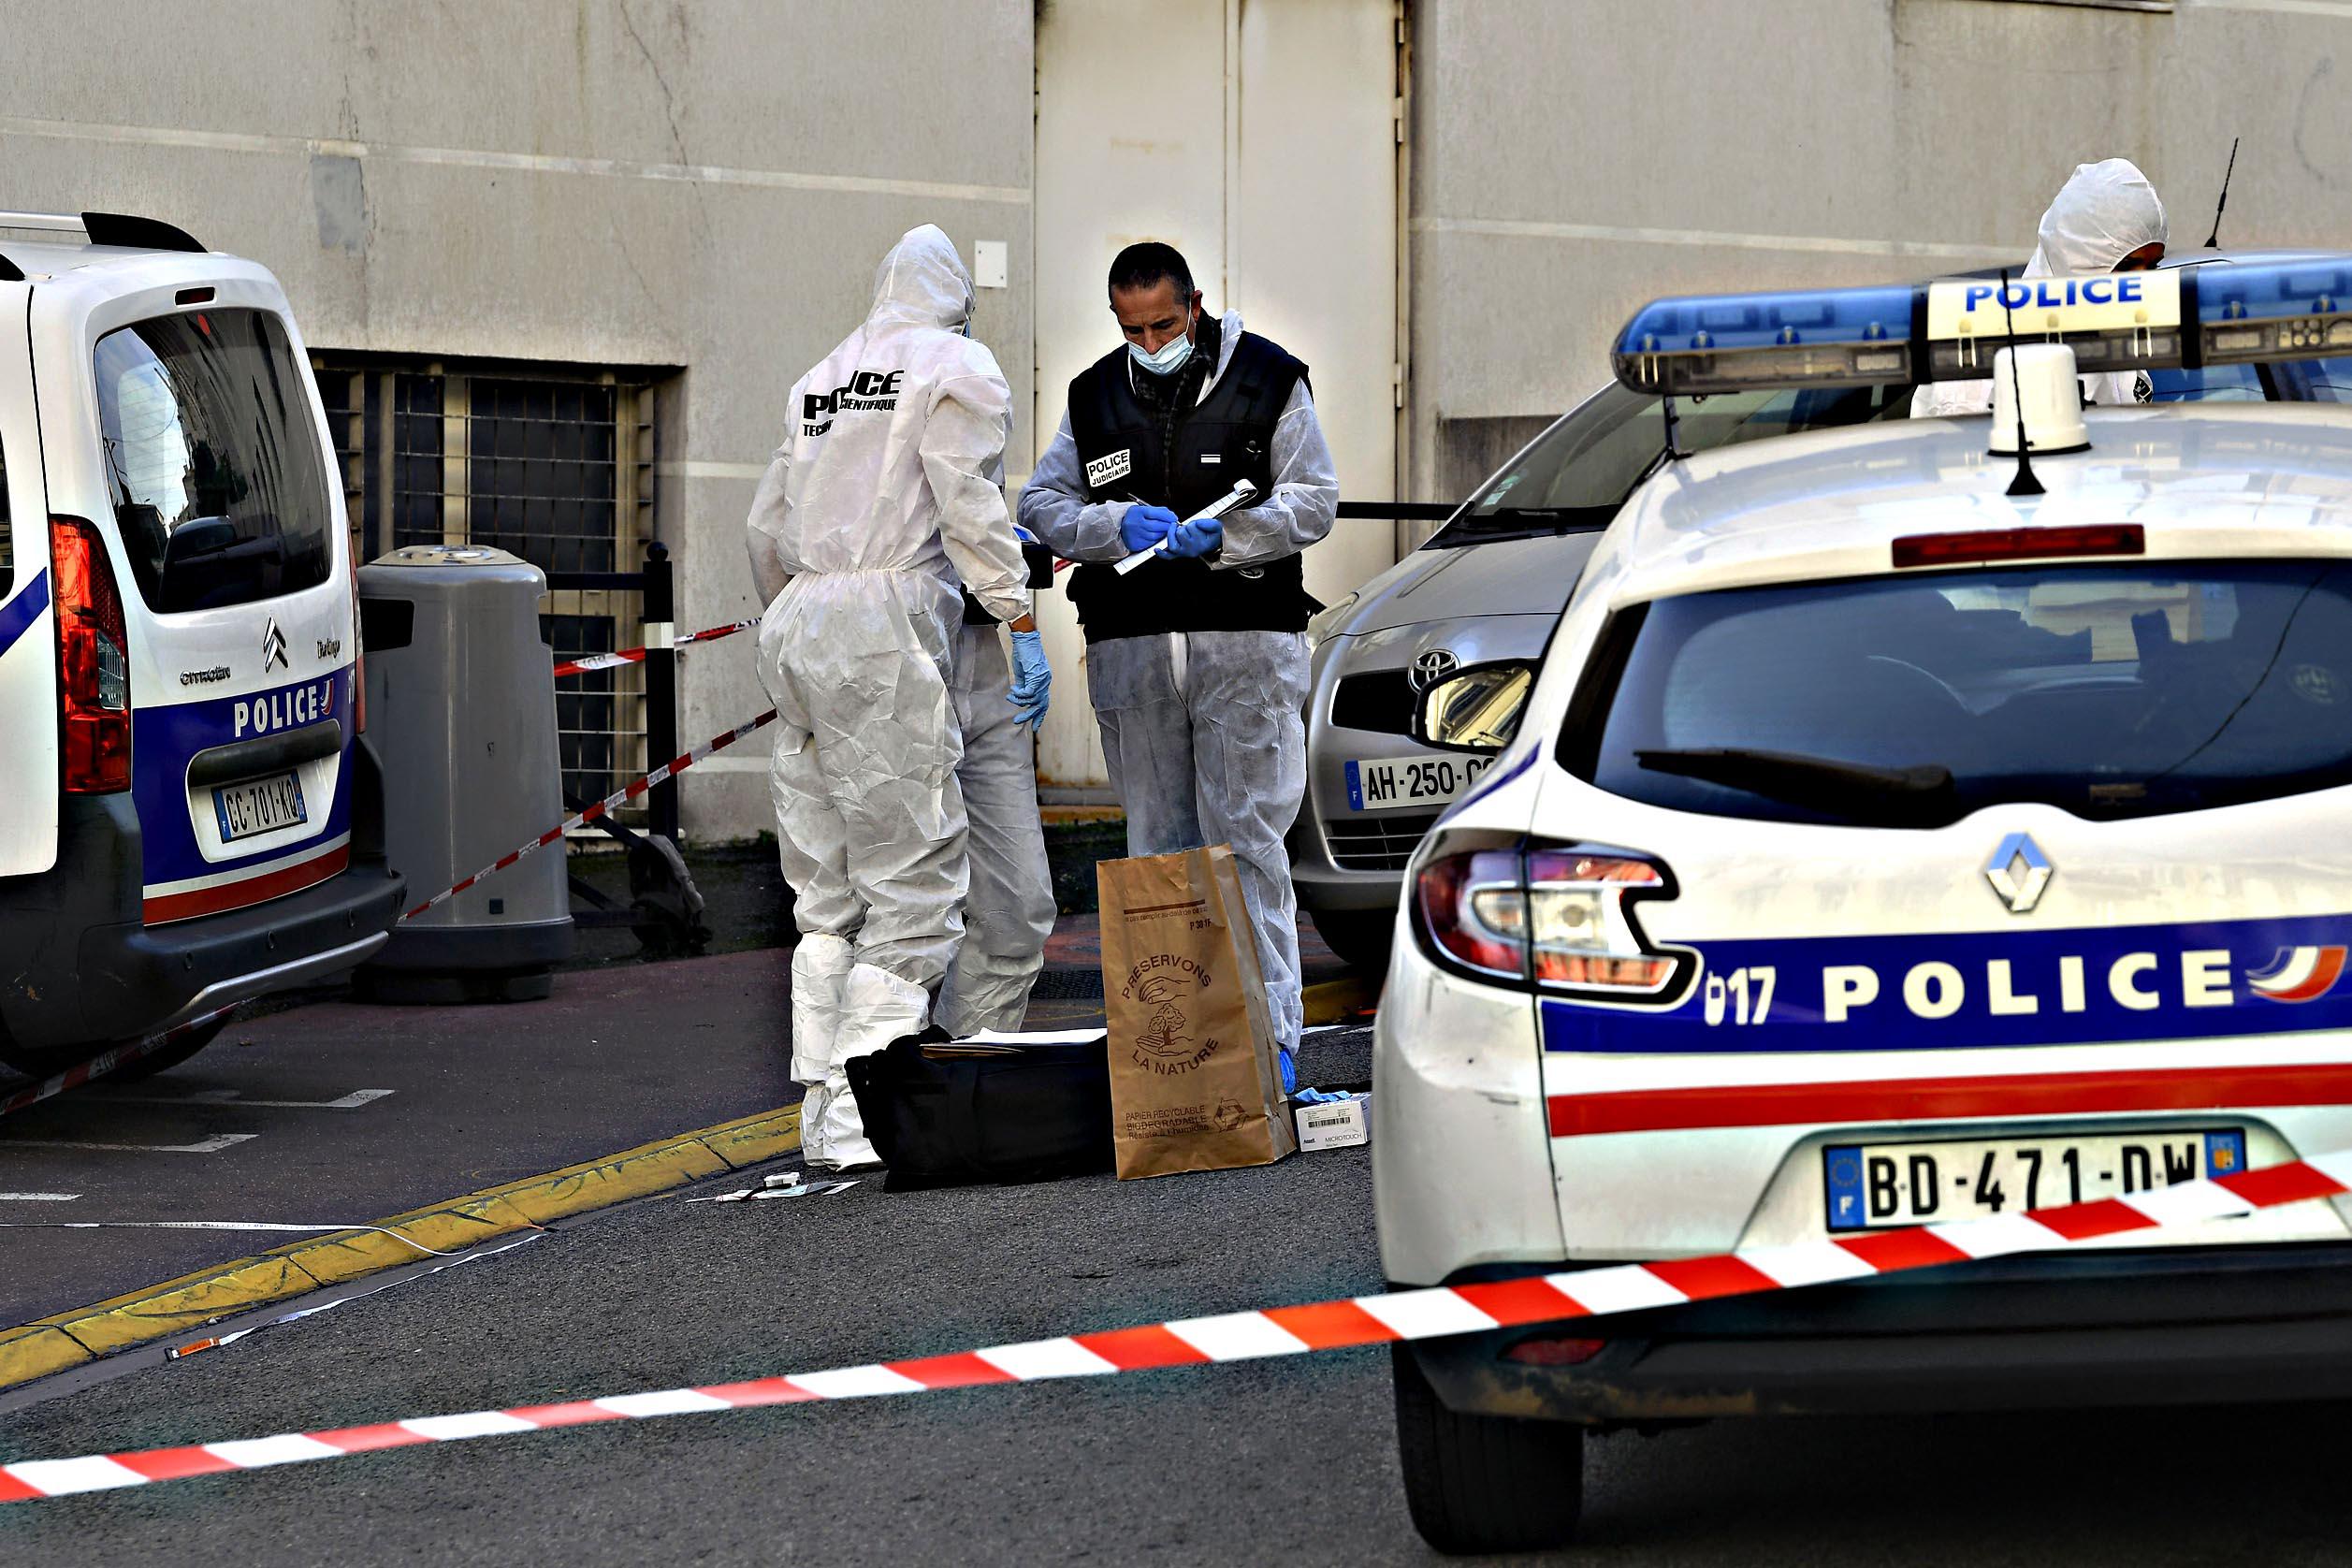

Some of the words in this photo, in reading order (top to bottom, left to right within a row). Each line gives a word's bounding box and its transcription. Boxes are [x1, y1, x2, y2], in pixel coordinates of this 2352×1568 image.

[1966, 276, 2142, 312] POLICE
[1088, 451, 1129, 477] POLICE
[1092, 464, 1130, 486] JUDICIAIRE
[234, 685, 318, 738] POLICE
[225, 778, 298, 834] CC-701-KQ
[1122, 954, 1212, 1000] PRESERVONS
[1727, 966, 1777, 1025] 17
[1822, 950, 2234, 1023] POLICE
[1132, 1049, 1150, 1071] LA
[1154, 1038, 1219, 1076] NATURE
[1125, 1111, 1153, 1122] PAPIER
[1154, 1105, 1206, 1119] RECYCLABLE
[1126, 1115, 1208, 1131] BIODEGRADABLE
[1869, 1142, 2197, 1218] BD-471-DW
[1838, 1196, 1855, 1216] F
